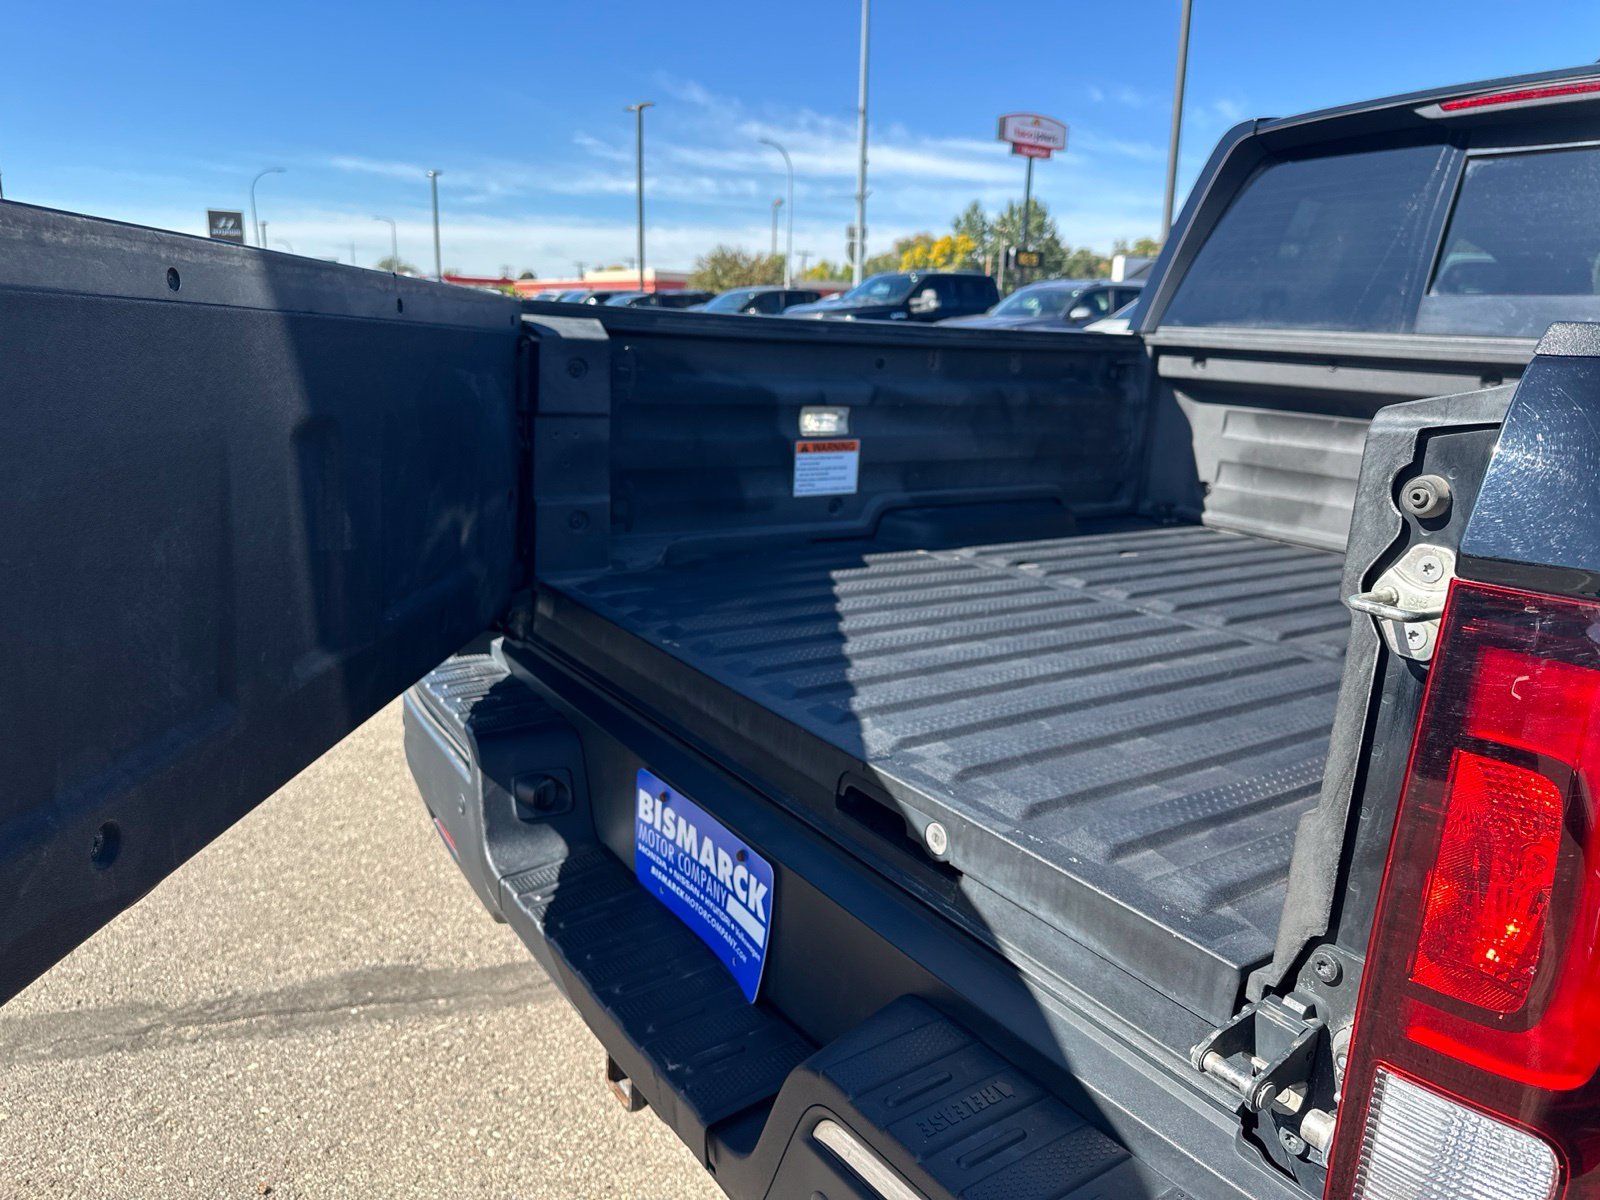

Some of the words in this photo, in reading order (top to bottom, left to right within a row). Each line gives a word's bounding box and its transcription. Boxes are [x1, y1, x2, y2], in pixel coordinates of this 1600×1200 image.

[638, 788, 768, 924] BISMARCK
[638, 823, 675, 865] MOTOR
[677, 852, 727, 908] COMPANY
[638, 842, 668, 870] HONDA
[673, 869, 701, 899] NISSAN
[916, 1087, 1003, 1138] RELEASE
